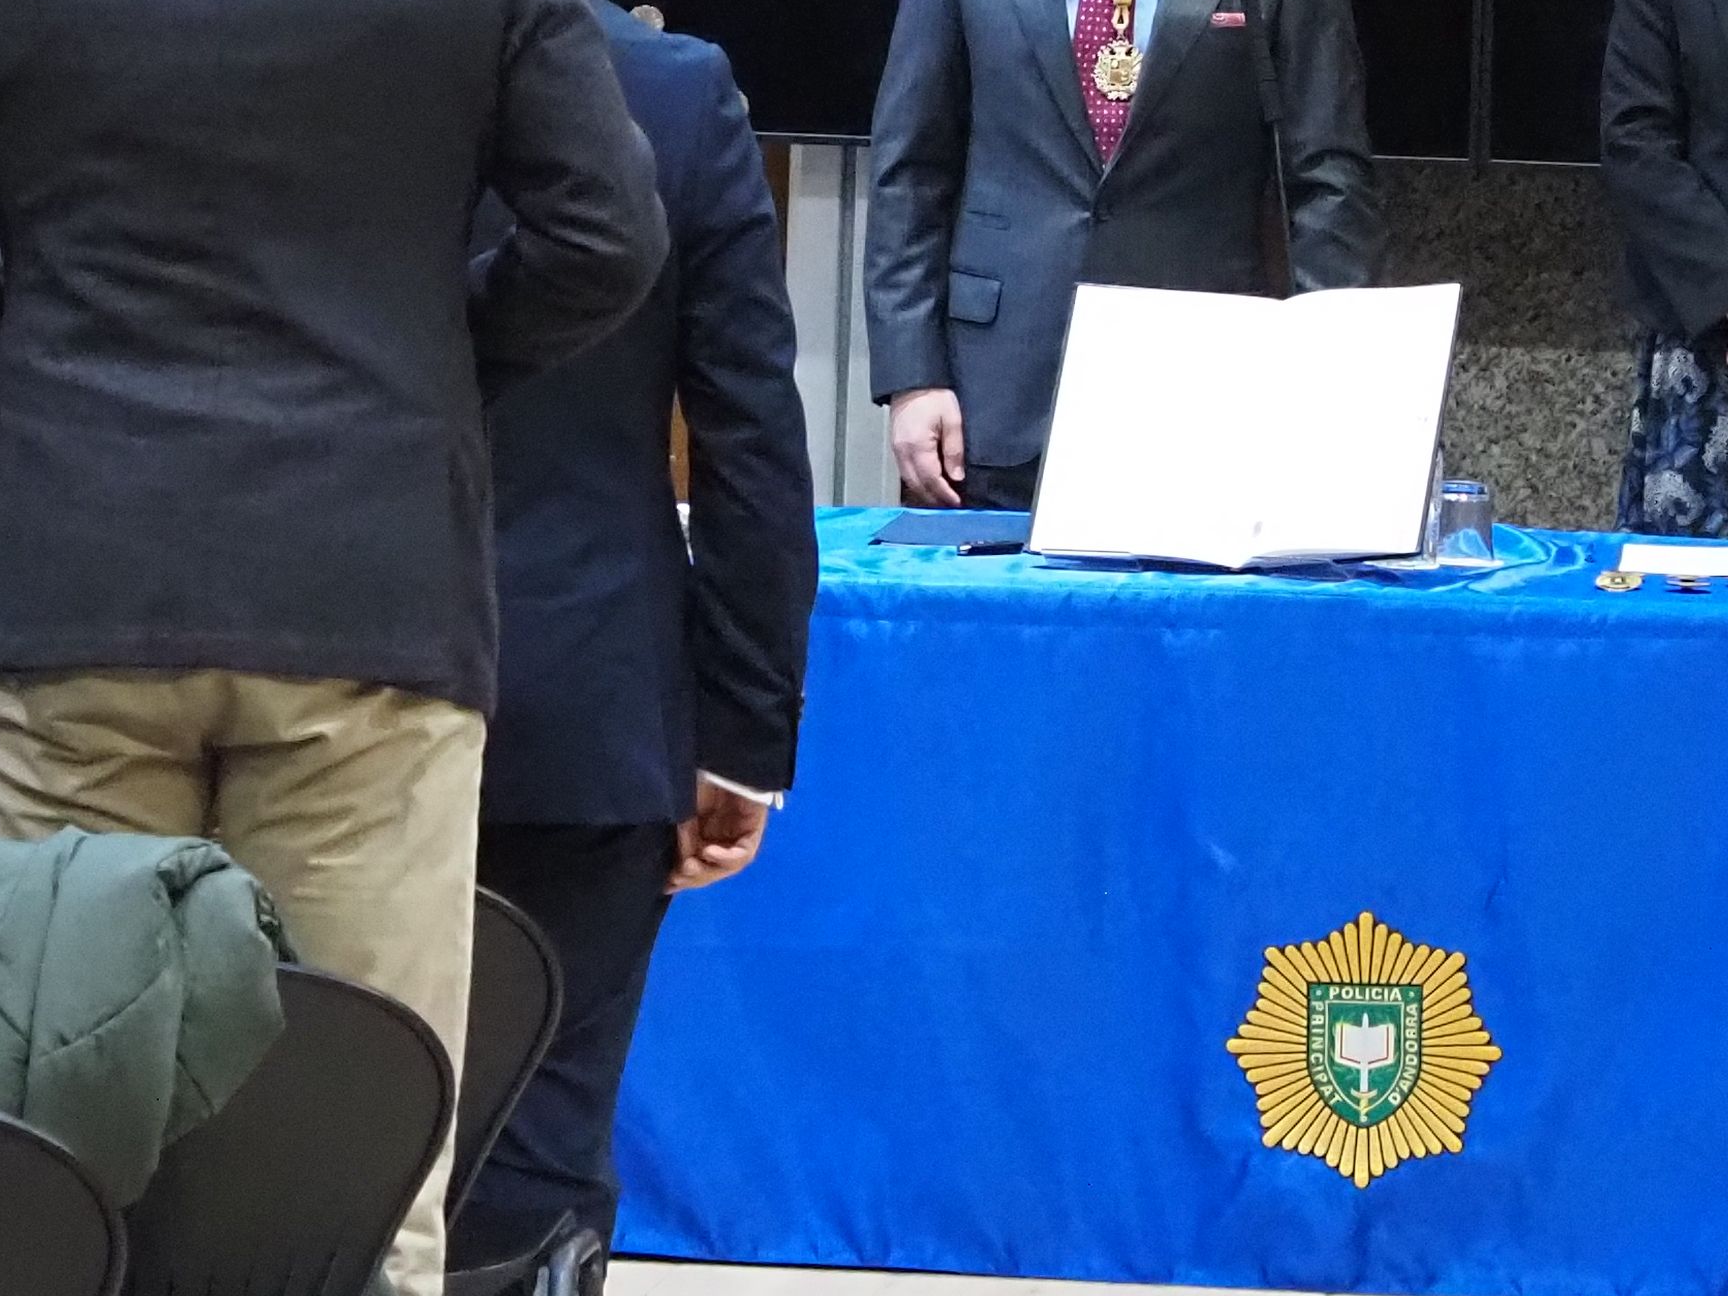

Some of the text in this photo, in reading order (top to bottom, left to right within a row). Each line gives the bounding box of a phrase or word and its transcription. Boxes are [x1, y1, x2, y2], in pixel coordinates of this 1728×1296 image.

[1328, 986, 1403, 1002] POLICIA
[1310, 1001, 1344, 1105] PRINCIPAT
[1387, 1004, 1419, 1106] D'ANDORRA
